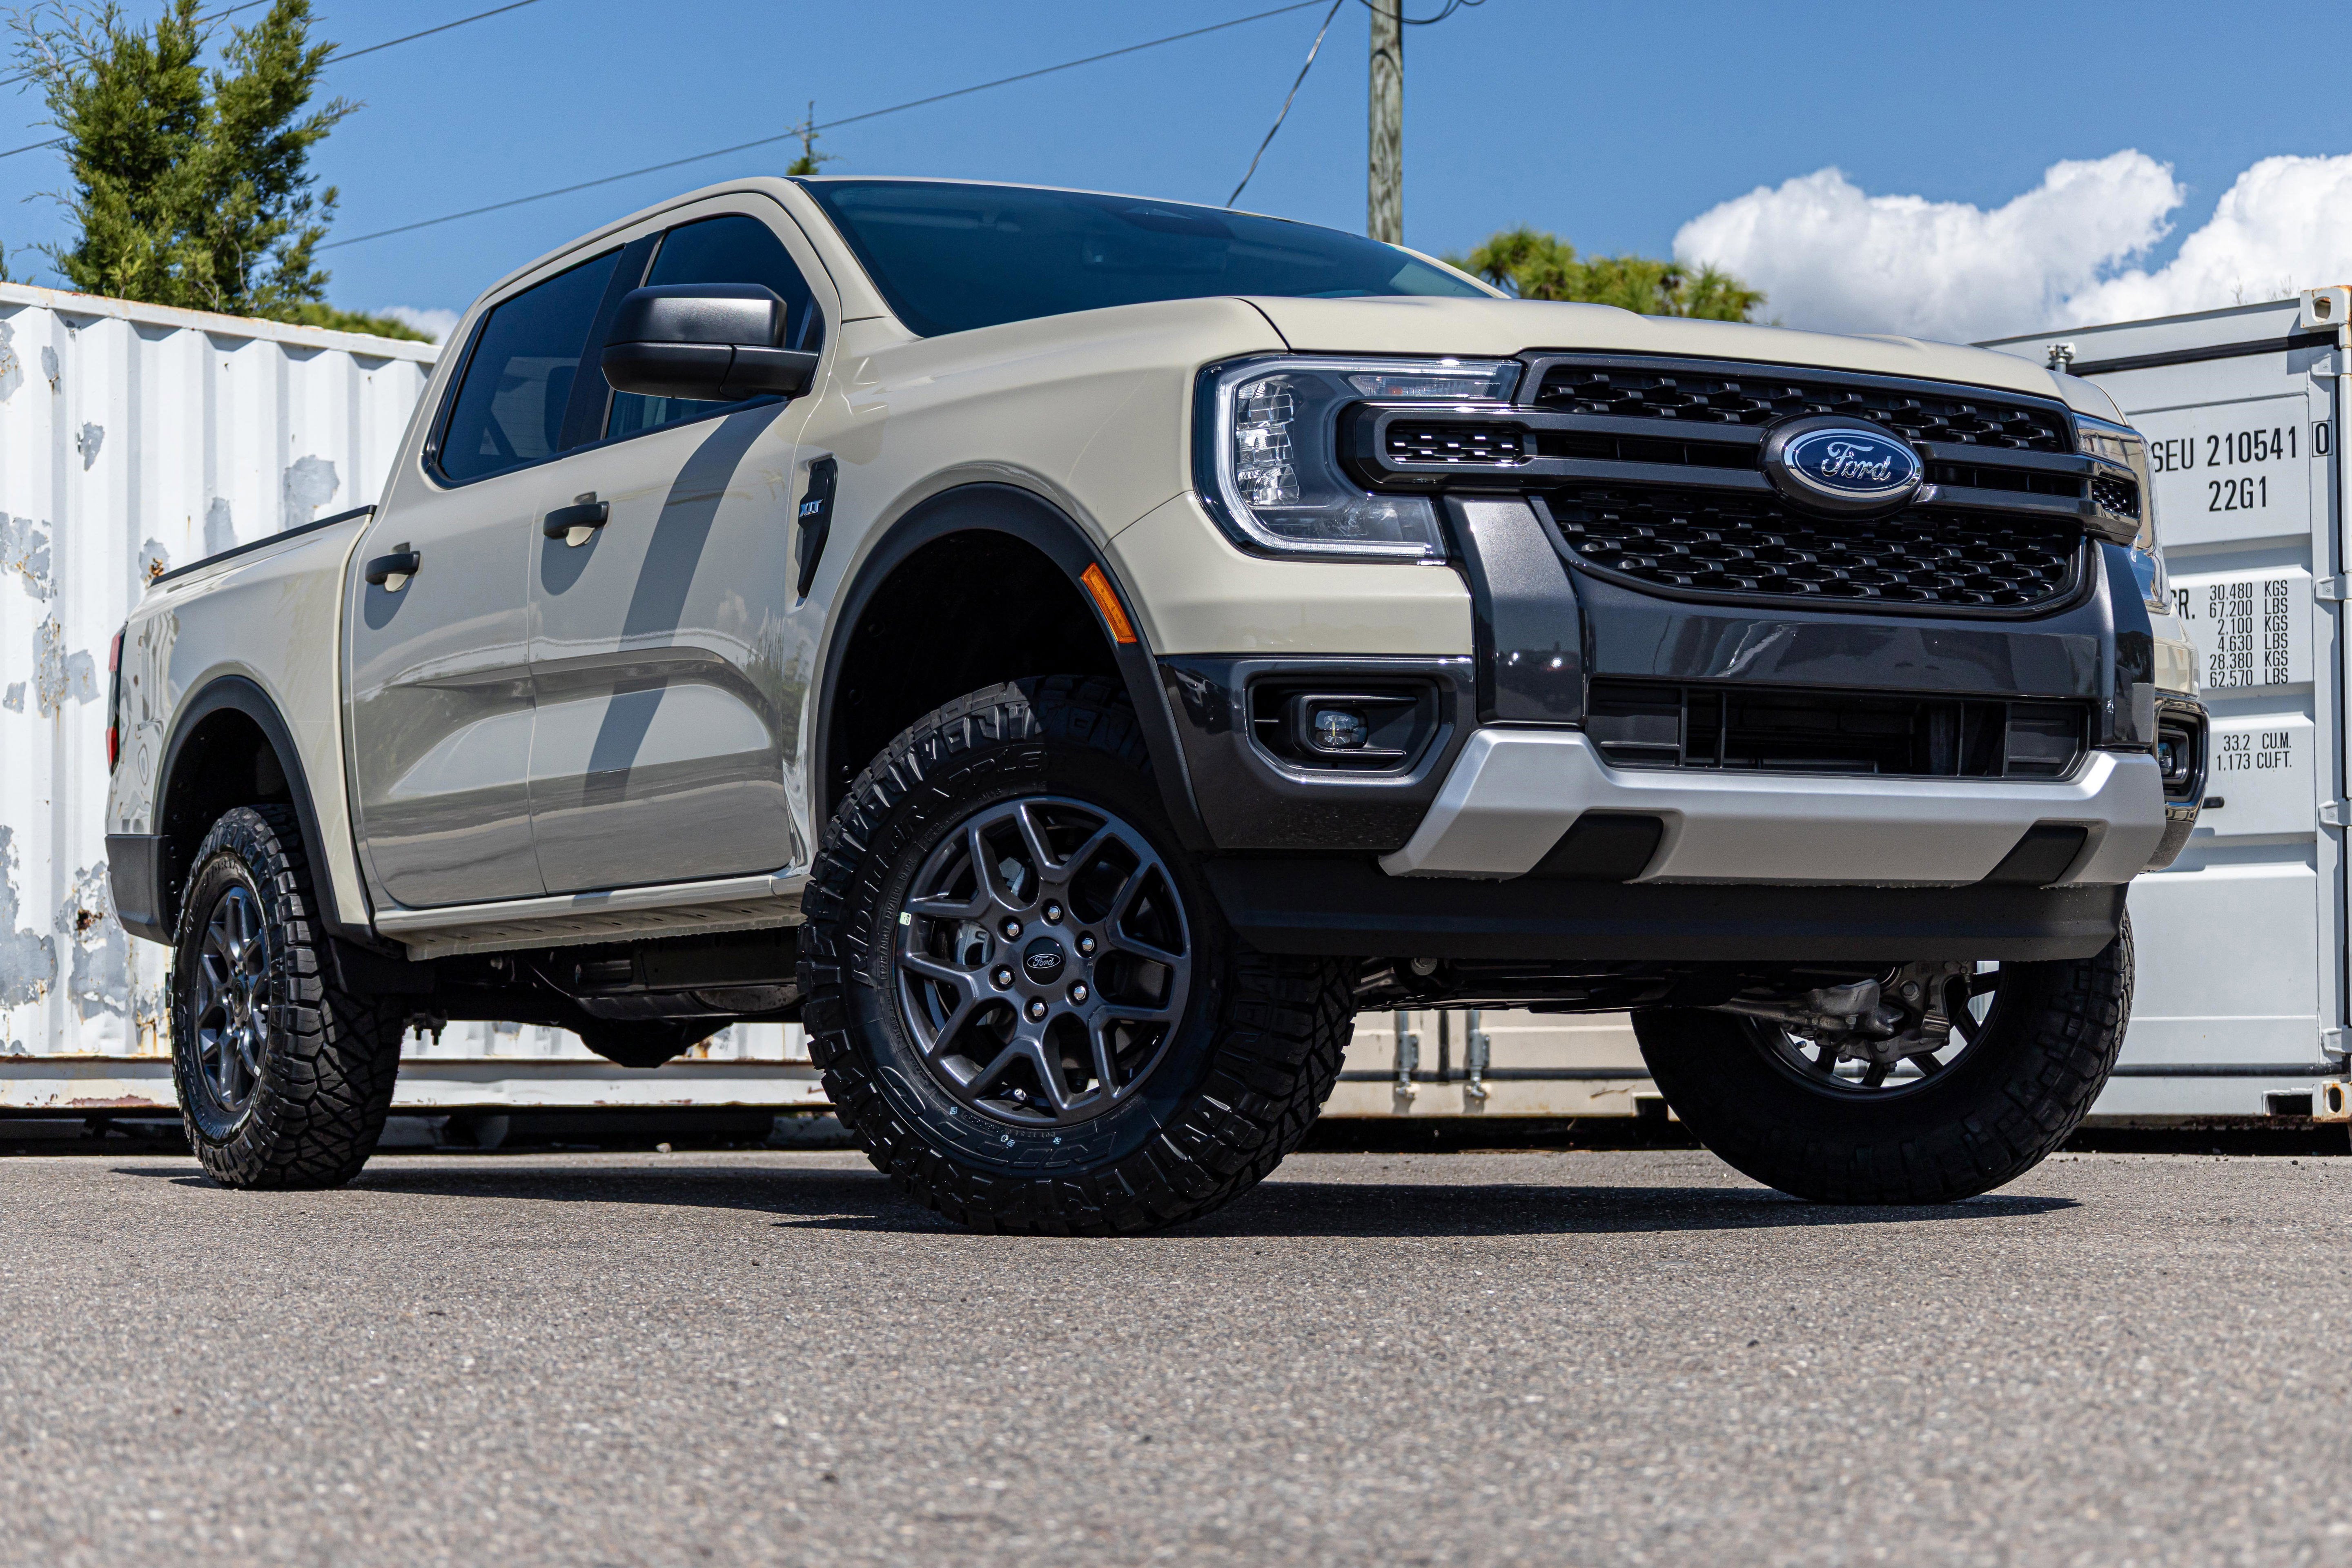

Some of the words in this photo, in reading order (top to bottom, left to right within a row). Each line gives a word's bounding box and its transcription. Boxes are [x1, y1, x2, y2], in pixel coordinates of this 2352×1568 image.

[2151, 437, 2194, 472] SEU
[2207, 426, 2296, 467] 210541
[2315, 422, 2329, 455] 0
[1821, 441, 1892, 481] Ford
[2208, 475, 2267, 512] 22G1
[799, 499, 824, 518] XLT
[2171, 588, 2195, 619] R.
[2209, 582, 2252, 601] 30,480
[2265, 580, 2288, 597] KGS
[2209, 599, 2252, 618] 67,200
[2265, 597, 2288, 615] LBS
[2218, 617, 2252, 635] 2,100
[2265, 615, 2288, 633] KGS
[2218, 635, 2253, 653] 4,630
[2265, 633, 2288, 650] LBS
[2210, 652, 2253, 670] 28,380
[2265, 650, 2288, 667] KGS
[2210, 669, 2253, 688] 62,570
[2265, 668, 2288, 685] LBS
[2223, 734, 2250, 752] 33.2
[2262, 732, 2292, 749] CU.M.
[2217, 753, 2250, 771] 1,173
[2257, 751, 2292, 769] CU.FT.
[1033, 955, 1054, 967] Ford
